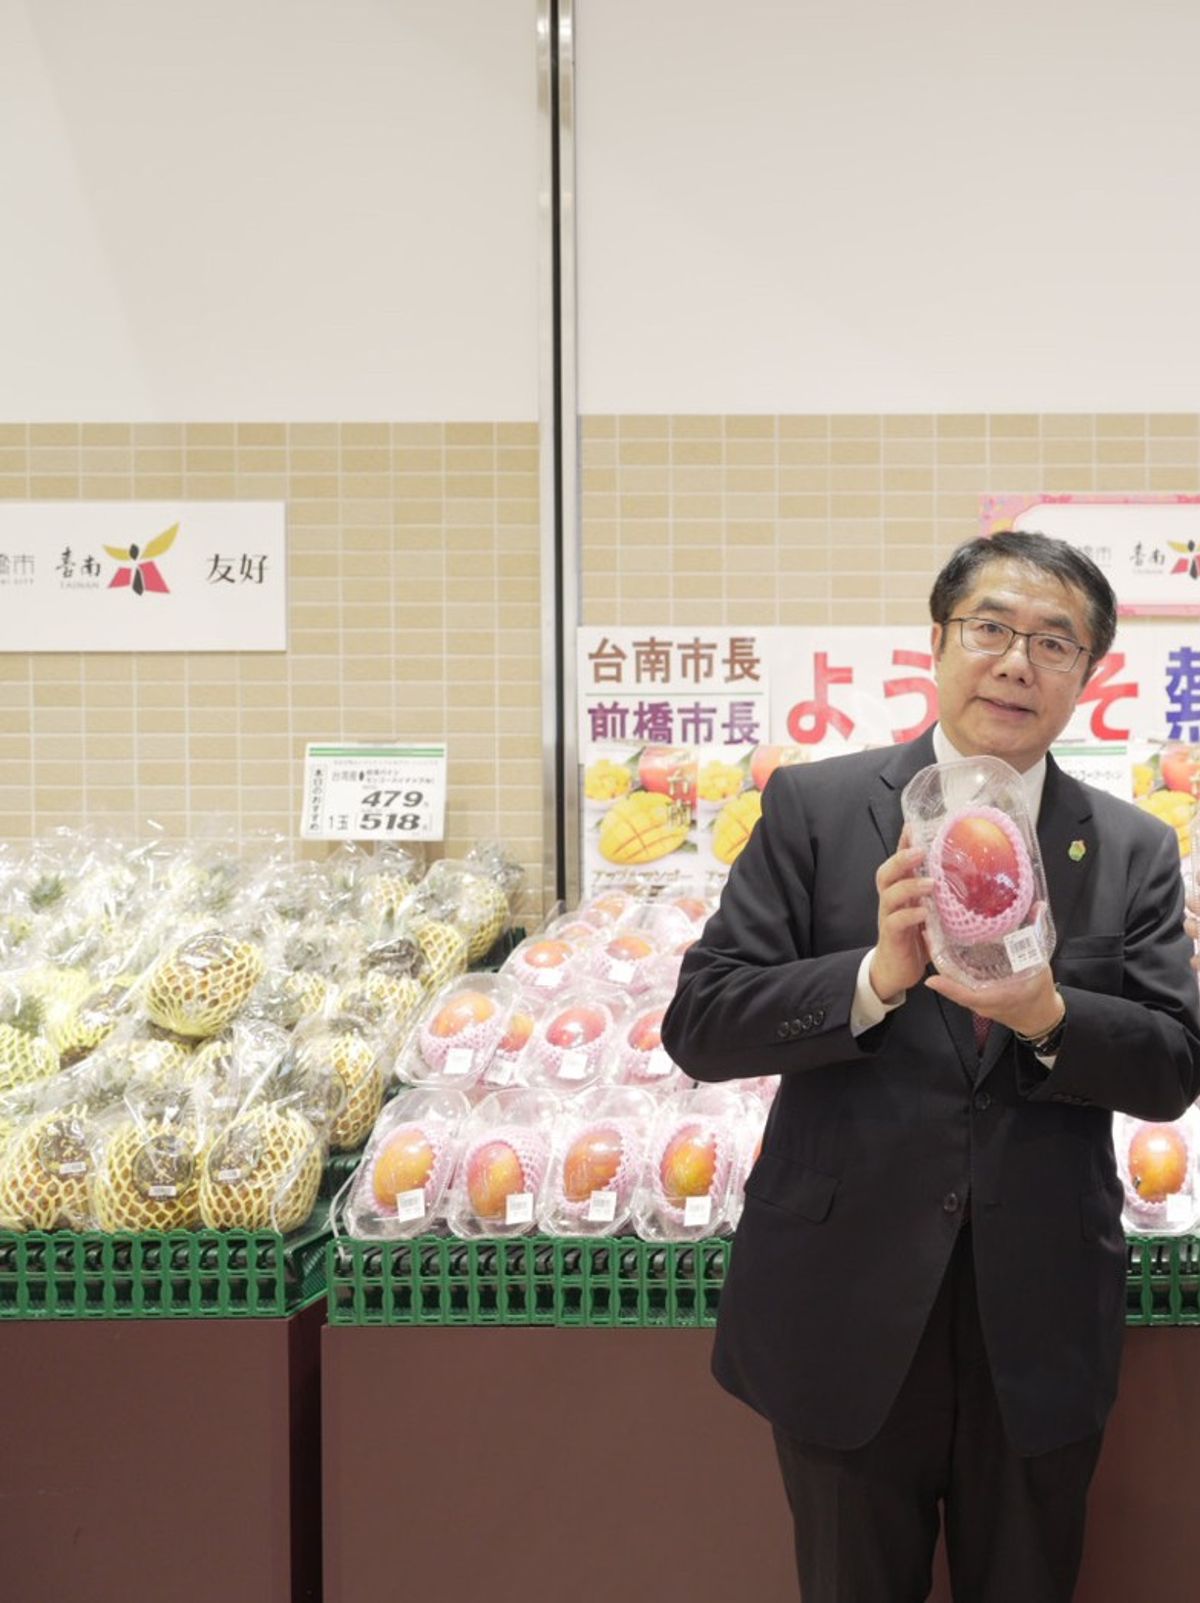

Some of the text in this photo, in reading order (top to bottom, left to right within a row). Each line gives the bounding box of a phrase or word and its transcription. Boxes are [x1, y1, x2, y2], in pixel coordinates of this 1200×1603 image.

[206, 553, 268, 584] 友好
[588, 637, 761, 683] 台南市長
[786, 649, 1139, 744] ようそ
[588, 701, 760, 745] 前橋市長
[361, 790, 424, 808] 479
[359, 813, 421, 831] 518
